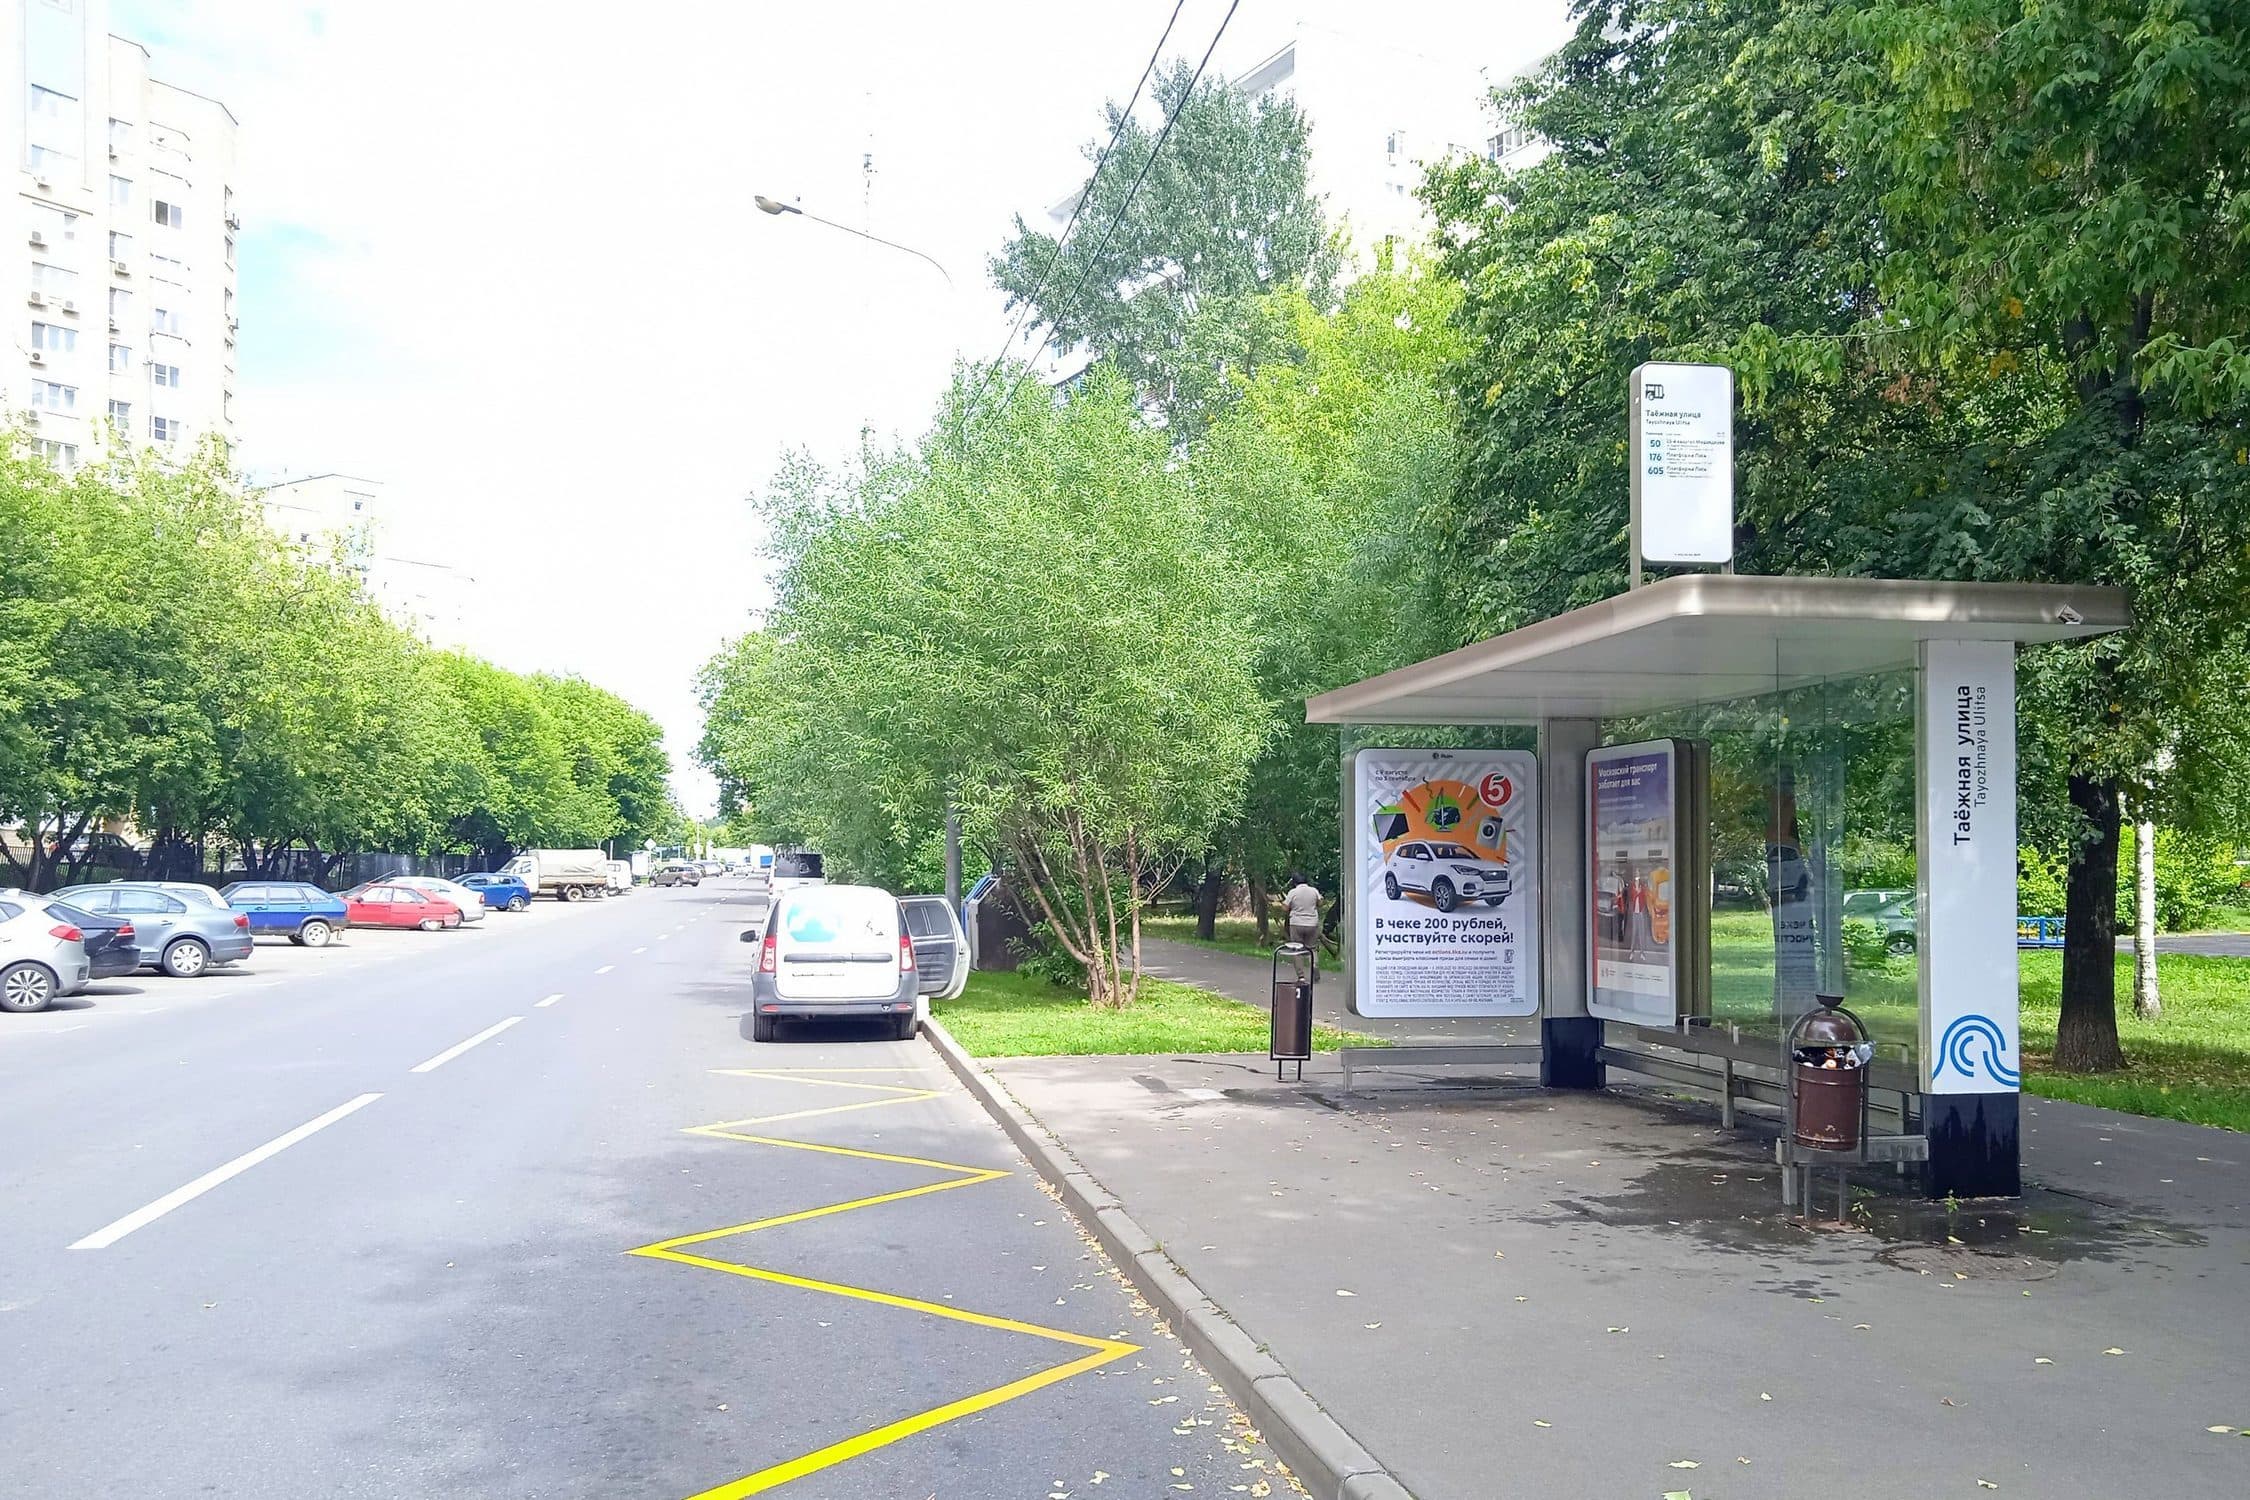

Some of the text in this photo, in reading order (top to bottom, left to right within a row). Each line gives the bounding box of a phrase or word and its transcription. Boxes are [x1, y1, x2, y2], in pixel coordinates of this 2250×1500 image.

[1645, 409, 1702, 419] Таёжная улица
[1650, 439, 1661, 448] 50
[1649, 453, 1662, 461] 176
[1648, 466, 1664, 475] 605
[1974, 686, 1989, 807] Tayozhnaya Ulitsa
[1598, 763, 1657, 777] Московский транспорт
[1953, 685, 1975, 846] Таёжная улица
[1598, 779, 1620, 789] работает
[1375, 917, 1507, 931] В чеке 200 рублей,
[1376, 932, 1514, 946] участвуйте скорей!
